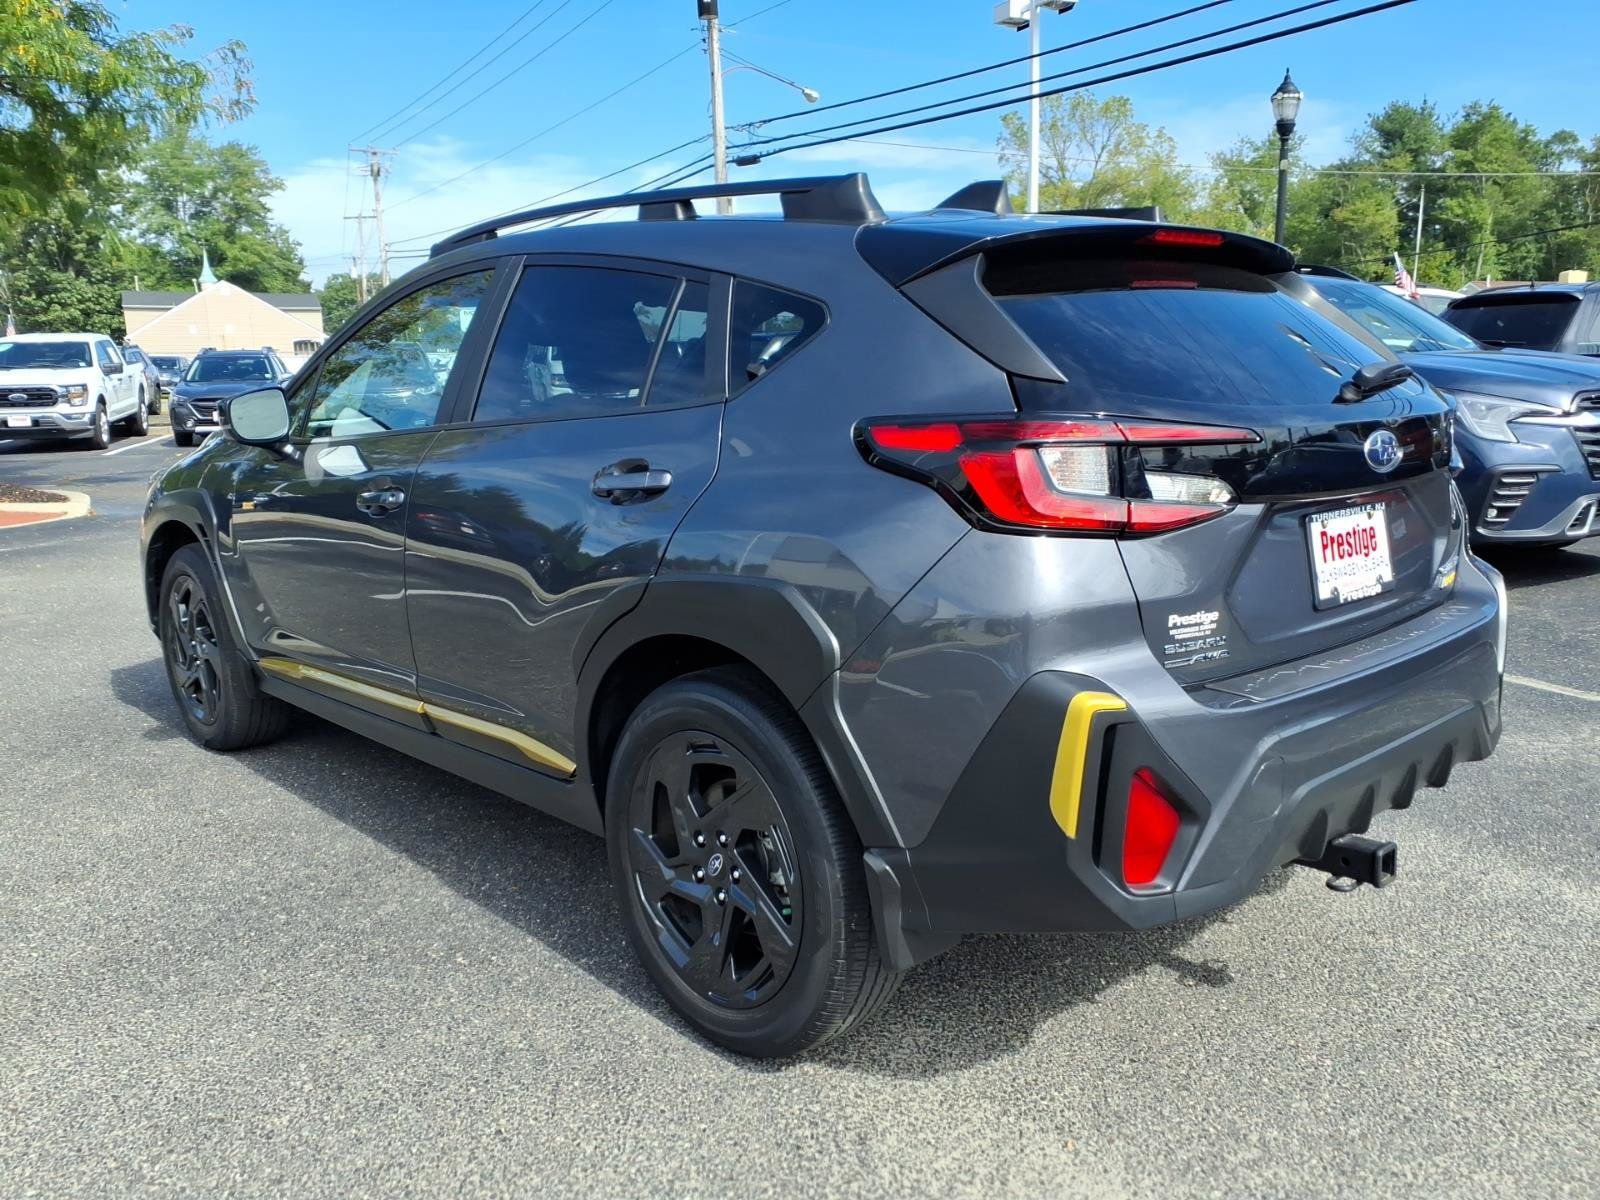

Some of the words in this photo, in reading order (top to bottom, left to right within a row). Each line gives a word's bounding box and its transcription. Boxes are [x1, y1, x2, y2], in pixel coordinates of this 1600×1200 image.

[1375, 502, 1386, 515] NJ
[1320, 524, 1378, 564] Prestige
[1339, 583, 1382, 603] Prestige
[1168, 610, 1220, 627] Prestige
[1164, 635, 1226, 654] SUBARU
